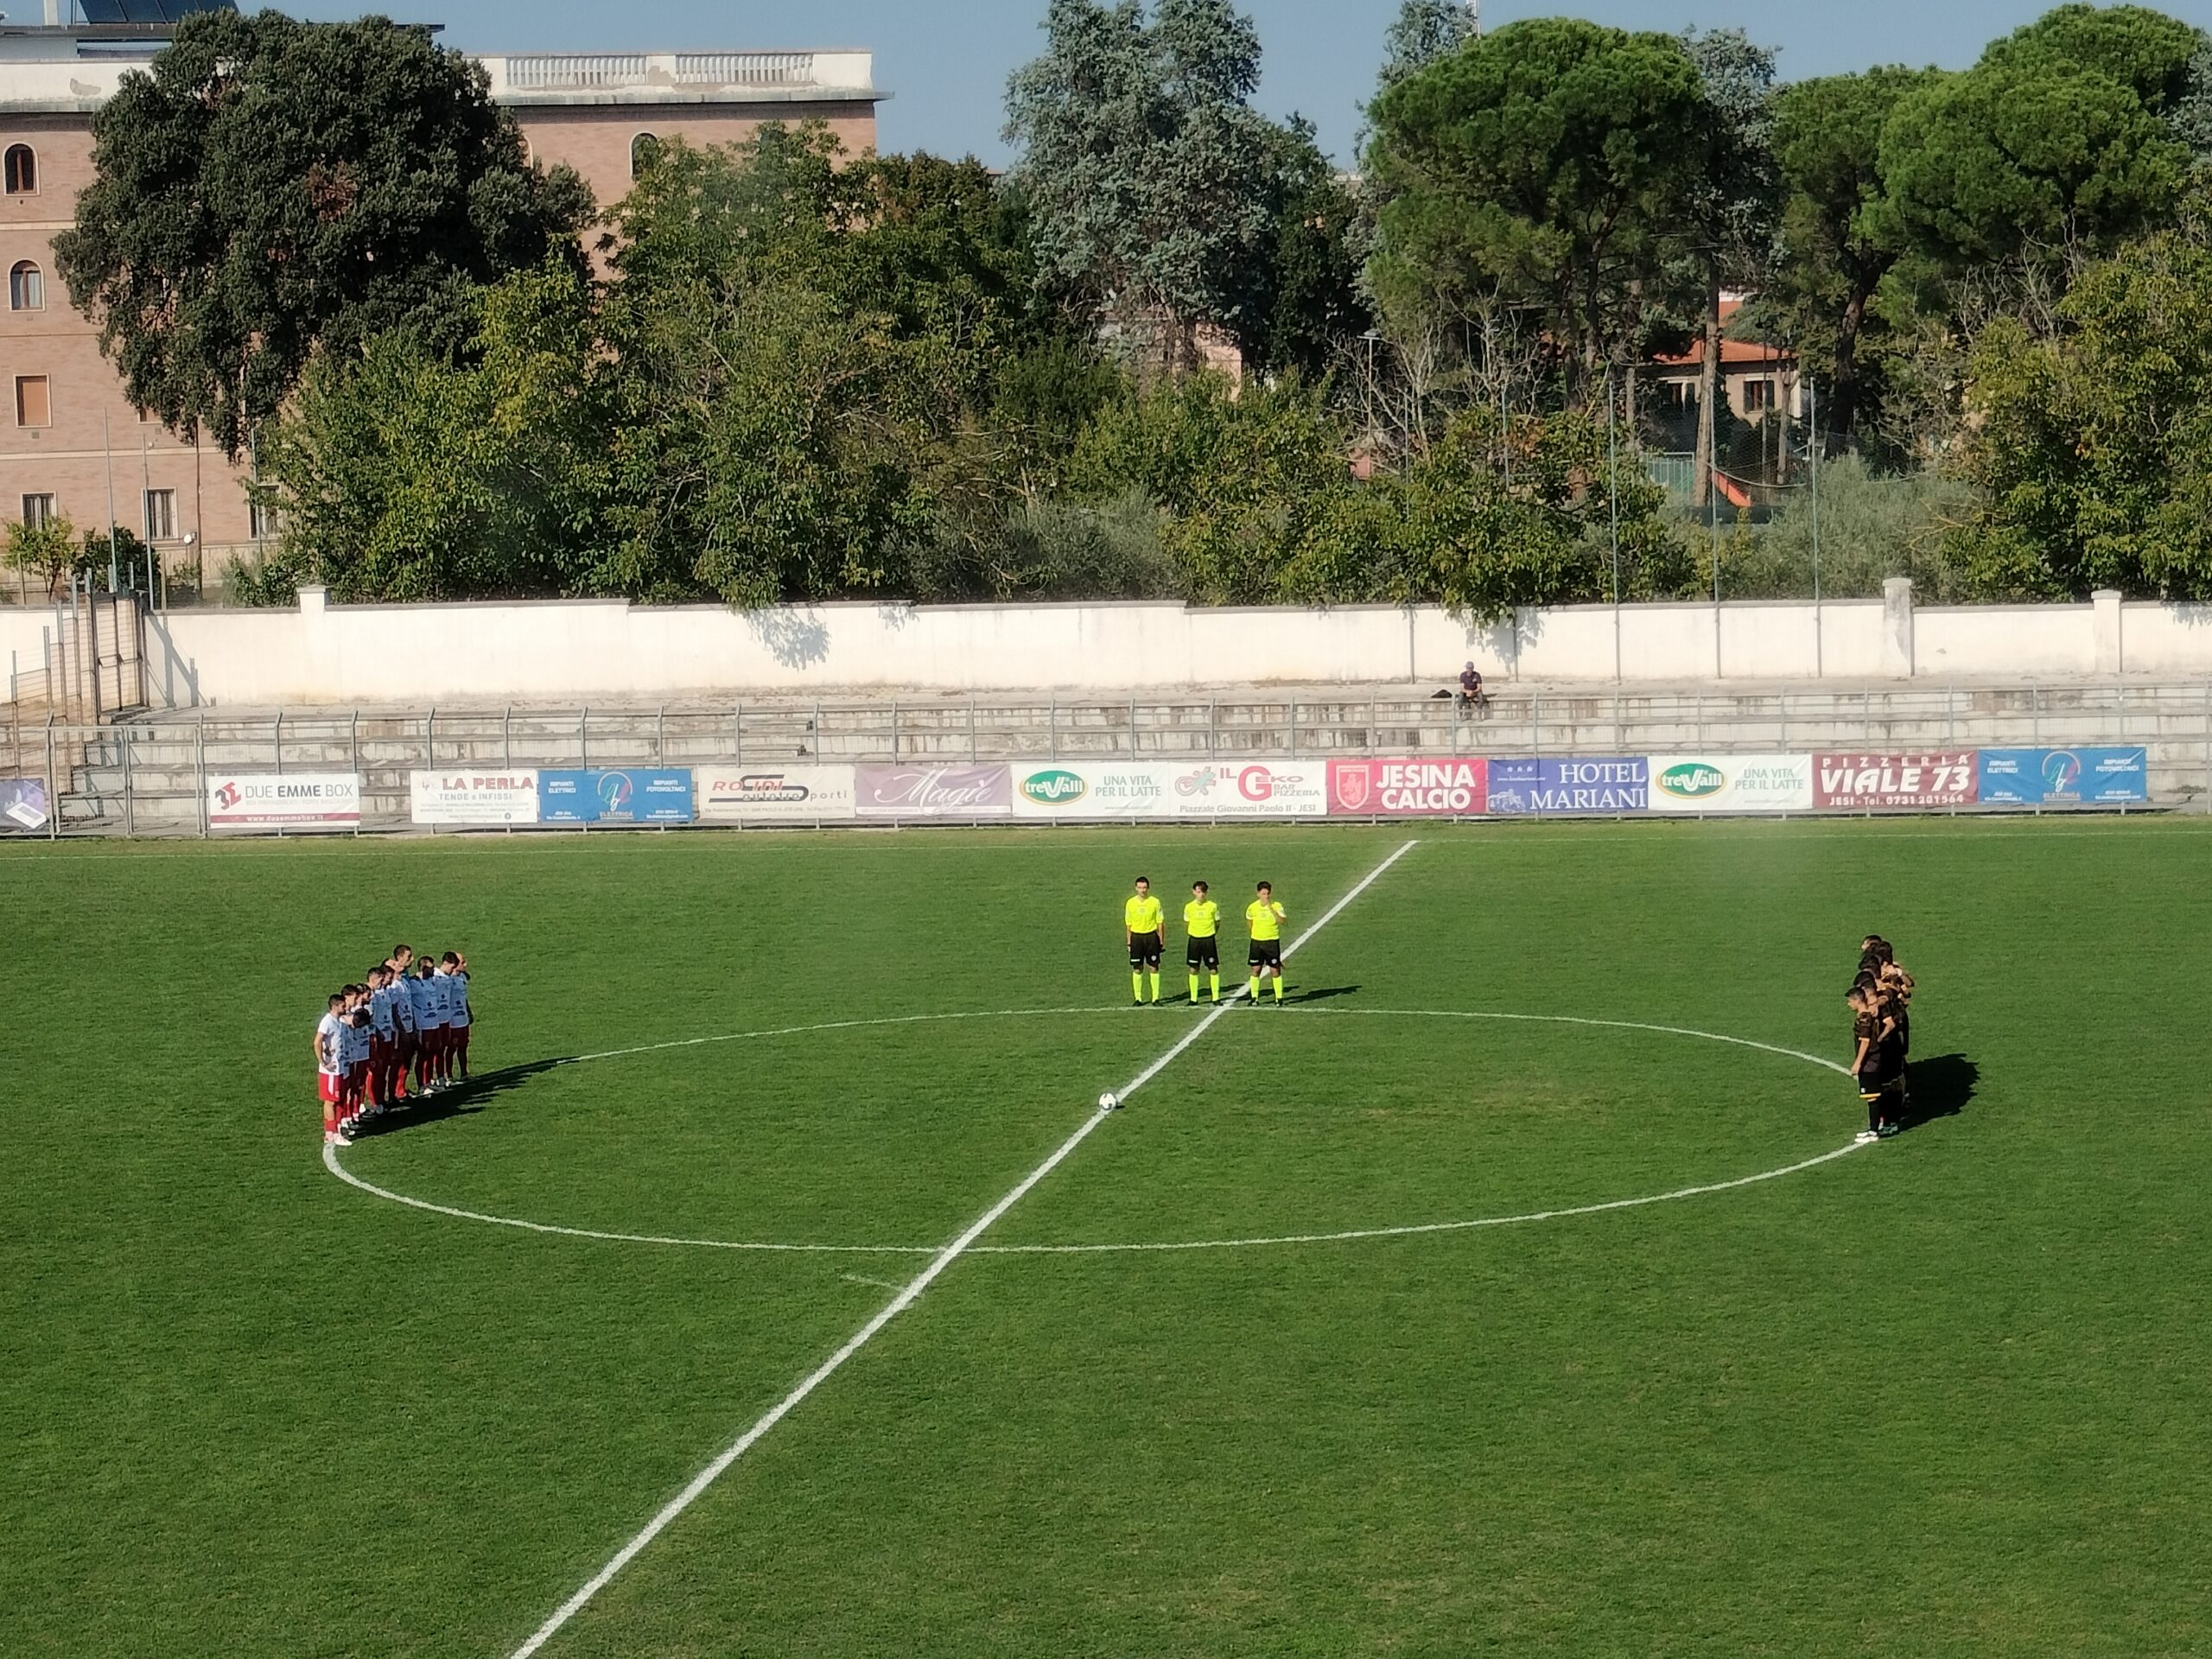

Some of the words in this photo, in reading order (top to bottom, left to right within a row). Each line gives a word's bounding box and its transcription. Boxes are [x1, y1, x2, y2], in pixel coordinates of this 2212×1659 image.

[1822, 755, 1968, 767] PIZZERIA
[1220, 768, 1237, 779] IL
[1376, 765, 1476, 788] JESINA
[1559, 763, 1646, 784] HOTEL
[1744, 769, 1768, 779] UNA
[1771, 768, 1795, 779] VITA
[442, 778, 467, 790] LA
[474, 777, 534, 790] PERLA
[1103, 776, 1125, 785] UNA
[1126, 776, 1153, 785] VITA
[1735, 779, 1758, 790] PER
[1759, 779, 1769, 790] IL
[1771, 779, 1803, 790] LATTE
[1821, 767, 1921, 795] VIALE
[1931, 766, 1970, 791] 73
[245, 785, 273, 798] DUE
[277, 785, 321, 798] EMME
[326, 784, 353, 797] BOX
[1096, 787, 1116, 797] PER
[1119, 787, 1128, 797] IL
[1131, 786, 1161, 797] LATTE
[1382, 788, 1471, 810] CALCIO
[1529, 788, 1646, 810] MARIANI
[1829, 797, 1853, 806] JESI
[1886, 795, 1915, 805] 0731
[1919, 794, 1964, 804] 201564
